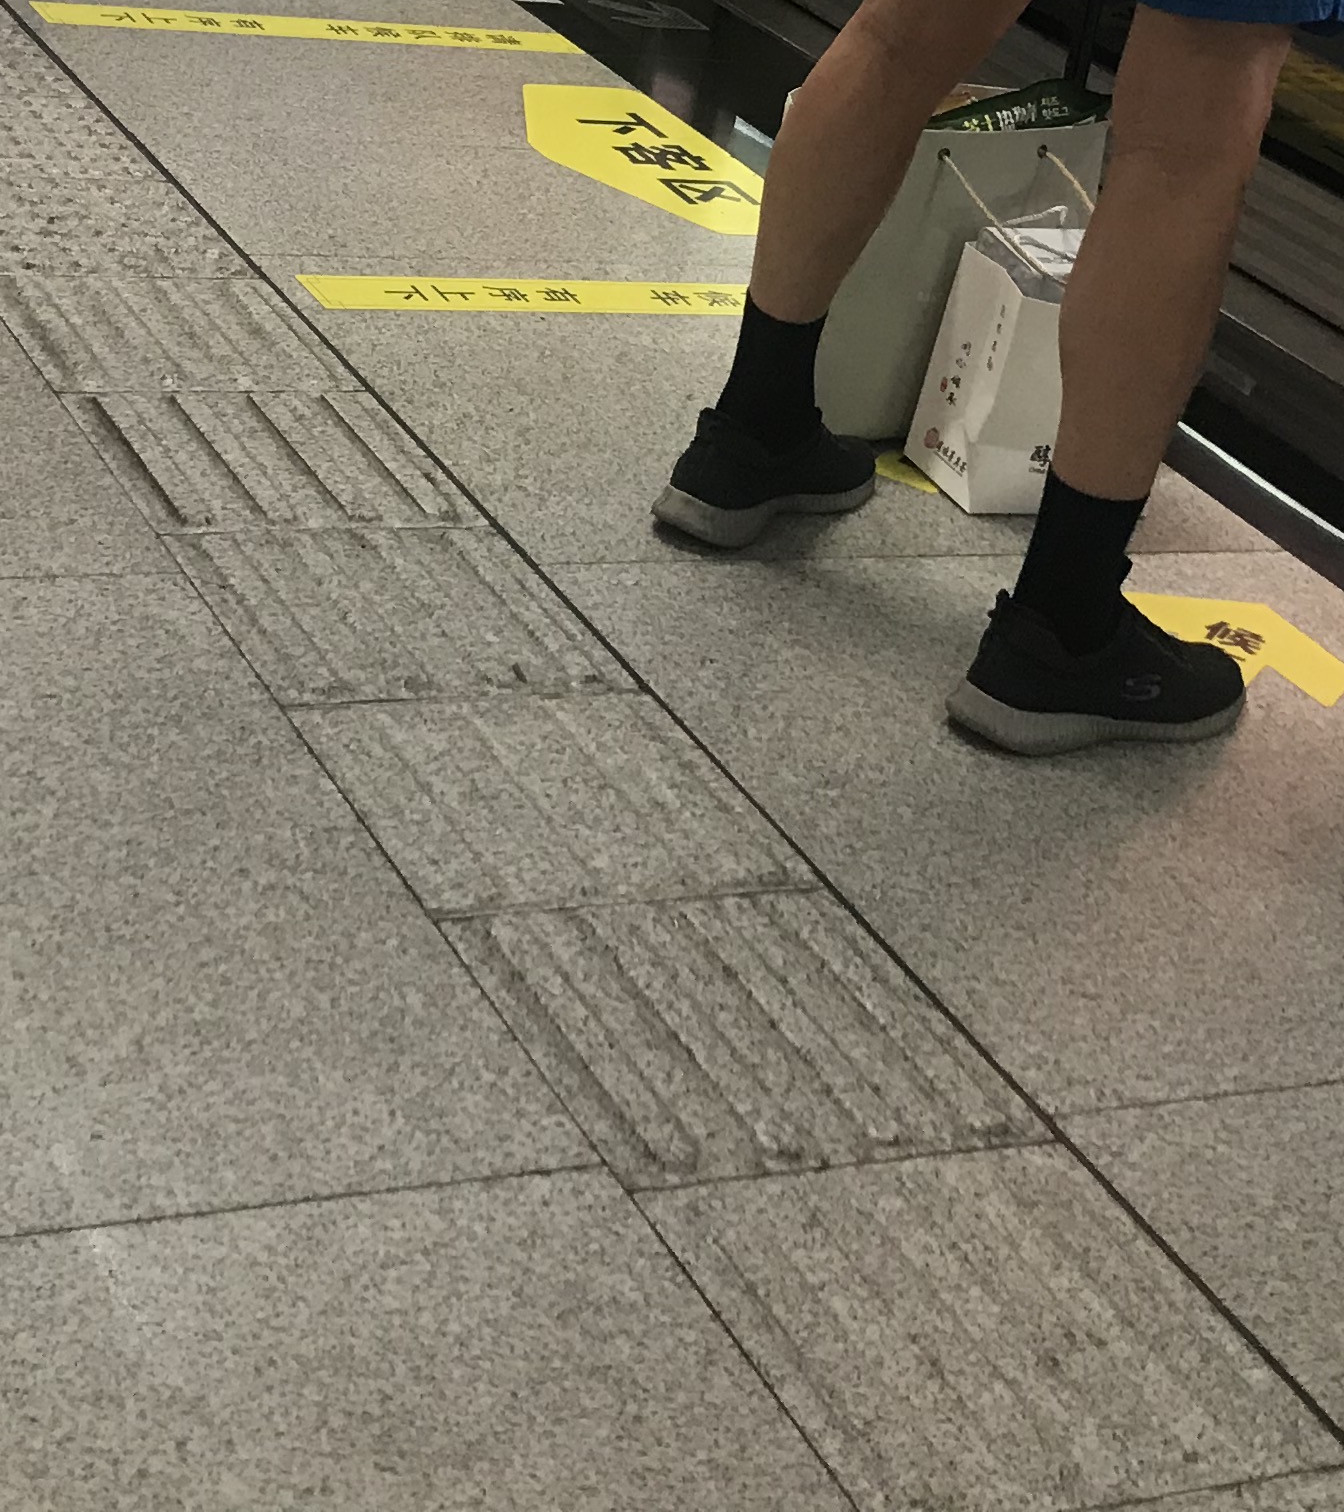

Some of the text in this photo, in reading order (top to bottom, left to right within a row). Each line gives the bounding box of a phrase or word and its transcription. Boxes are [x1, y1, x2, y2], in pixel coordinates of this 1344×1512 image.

[575, 112, 761, 206] 下客区
[384, 283, 745, 309] 候车 有序上下
[1204, 620, 1266, 661] 候
